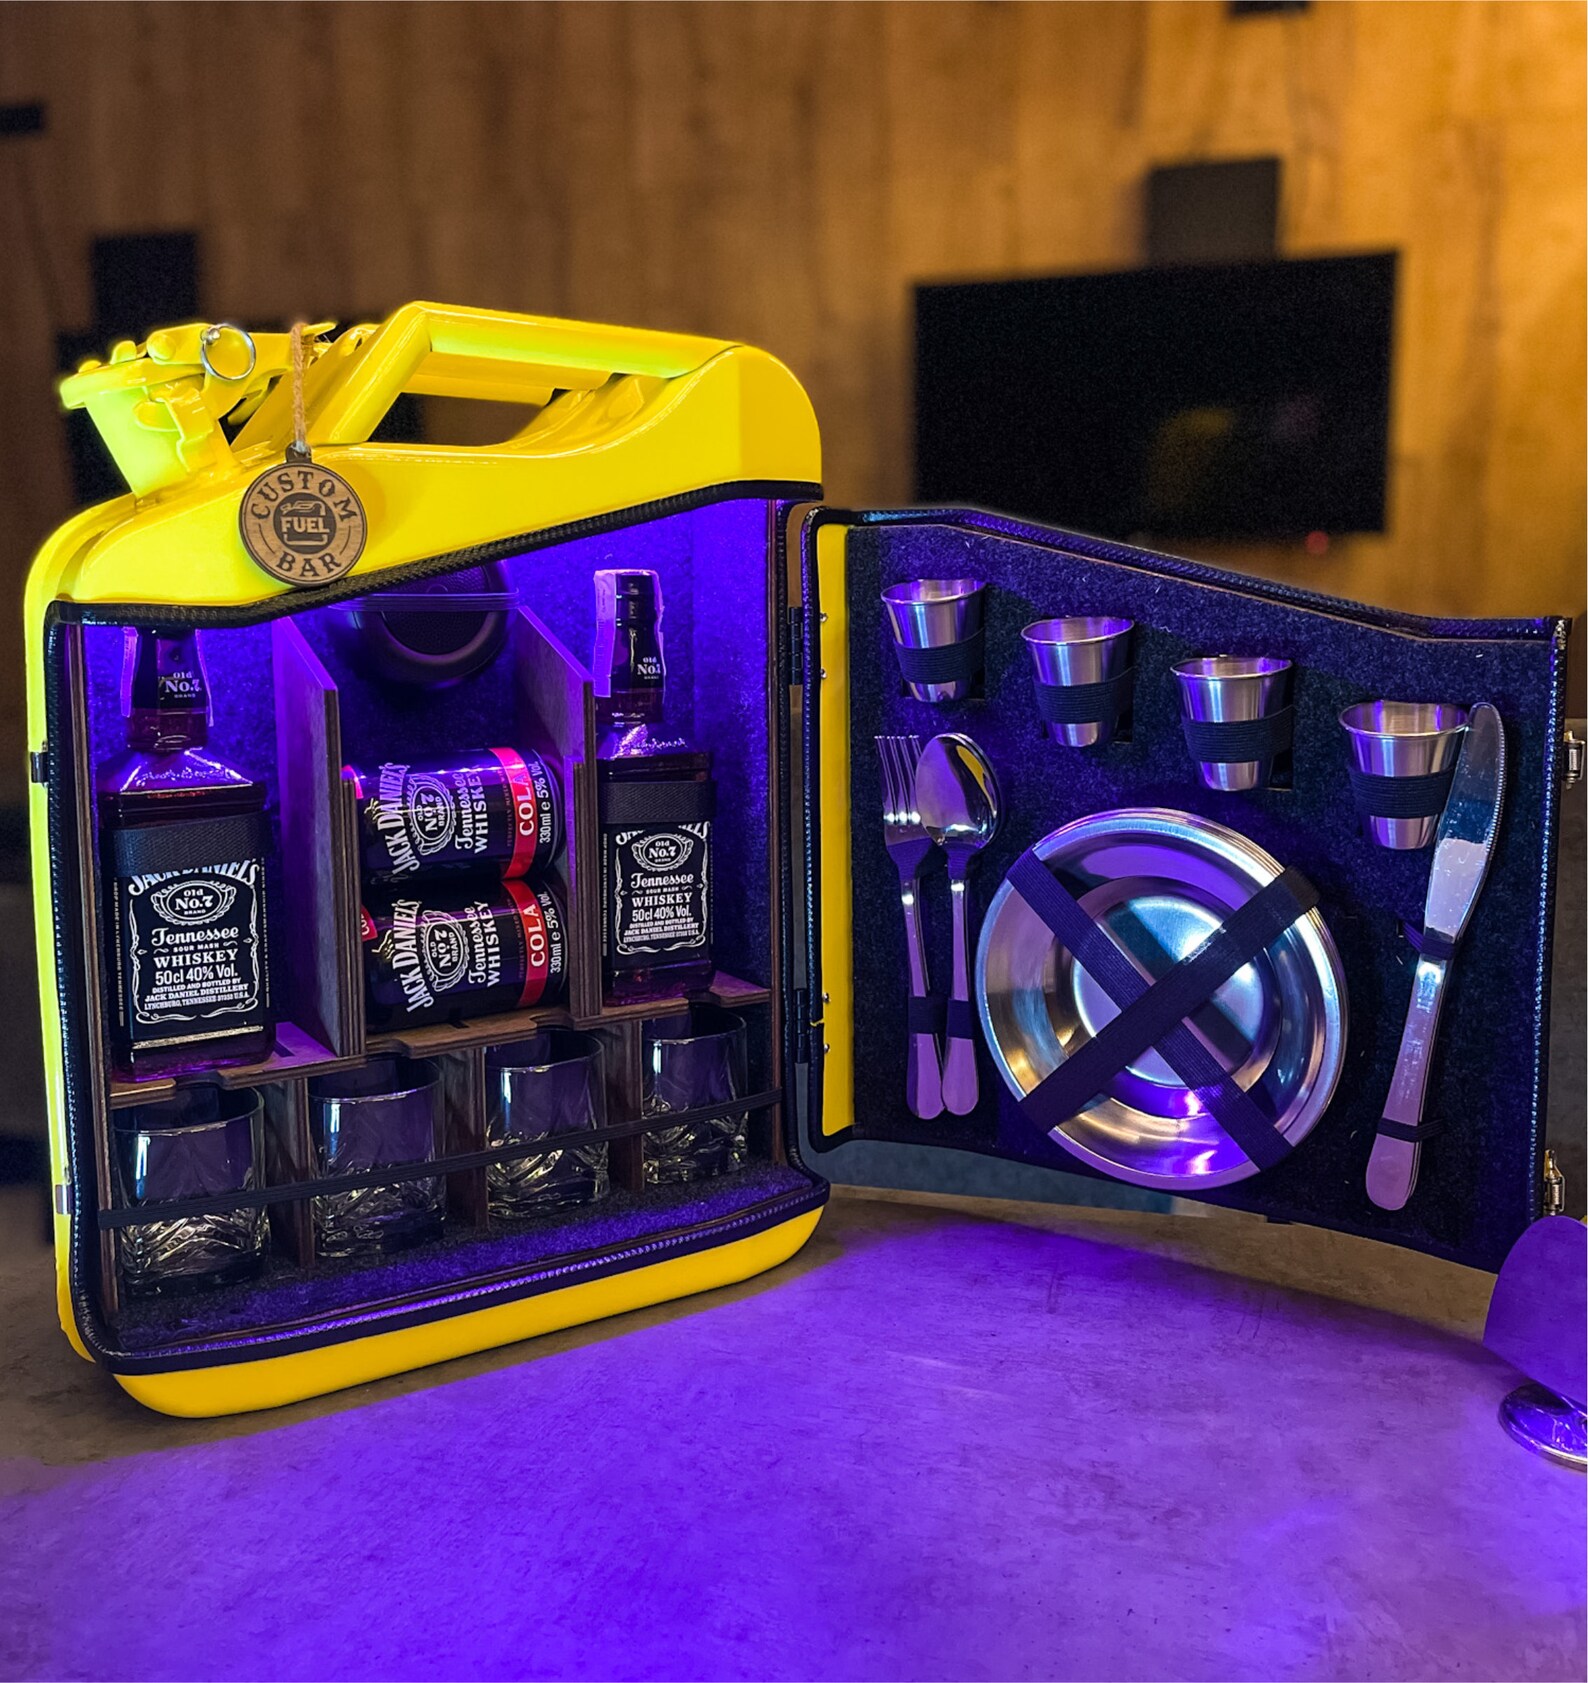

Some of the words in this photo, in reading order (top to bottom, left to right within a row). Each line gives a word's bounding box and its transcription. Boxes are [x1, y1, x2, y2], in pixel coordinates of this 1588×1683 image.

[251, 470, 358, 522] CUSTOM
[280, 516, 330, 533] FUEL
[275, 551, 342, 577] BAR
[377, 762, 409, 831] DANIEL'S
[536, 778, 550, 799] 5%
[435, 796, 445, 827] BRAND
[452, 773, 474, 850] Tennessee
[468, 768, 488, 854] WHISKEY
[510, 774, 534, 836] COLA
[539, 812, 552, 844] 330ml
[385, 829, 421, 875] JACK
[648, 846, 676, 858] No.7
[630, 873, 694, 888] Tennessee
[175, 895, 214, 910] No.7
[537, 891, 551, 906] Vol.
[632, 892, 693, 908] WHISKEY
[544, 908, 558, 929] 5%
[632, 908, 653, 922] 50cl
[654, 906, 674, 919] 40%
[675, 904, 691, 917] Vol.
[151, 927, 239, 946] Tennessee
[391, 899, 420, 970] DANIEL'S
[448, 932, 458, 962] BRAND
[466, 907, 486, 984] Tennessee
[474, 901, 500, 988] WHISKEY
[523, 904, 546, 967] COLA
[153, 949, 238, 968] WHISKEY
[173, 945, 194, 953] SOUR
[550, 942, 562, 974] 330ml
[152, 984, 186, 994] DISTILLED
[202, 980, 230, 988] BOTTLED
[155, 969, 184, 986] 50cl
[186, 965, 214, 981] 40%
[216, 963, 238, 978] Vol.
[145, 994, 166, 1002] JACK
[168, 991, 199, 1000] DANIEL
[200, 983, 249, 996] DISTILLERY
[400, 968, 435, 1012] JACK
